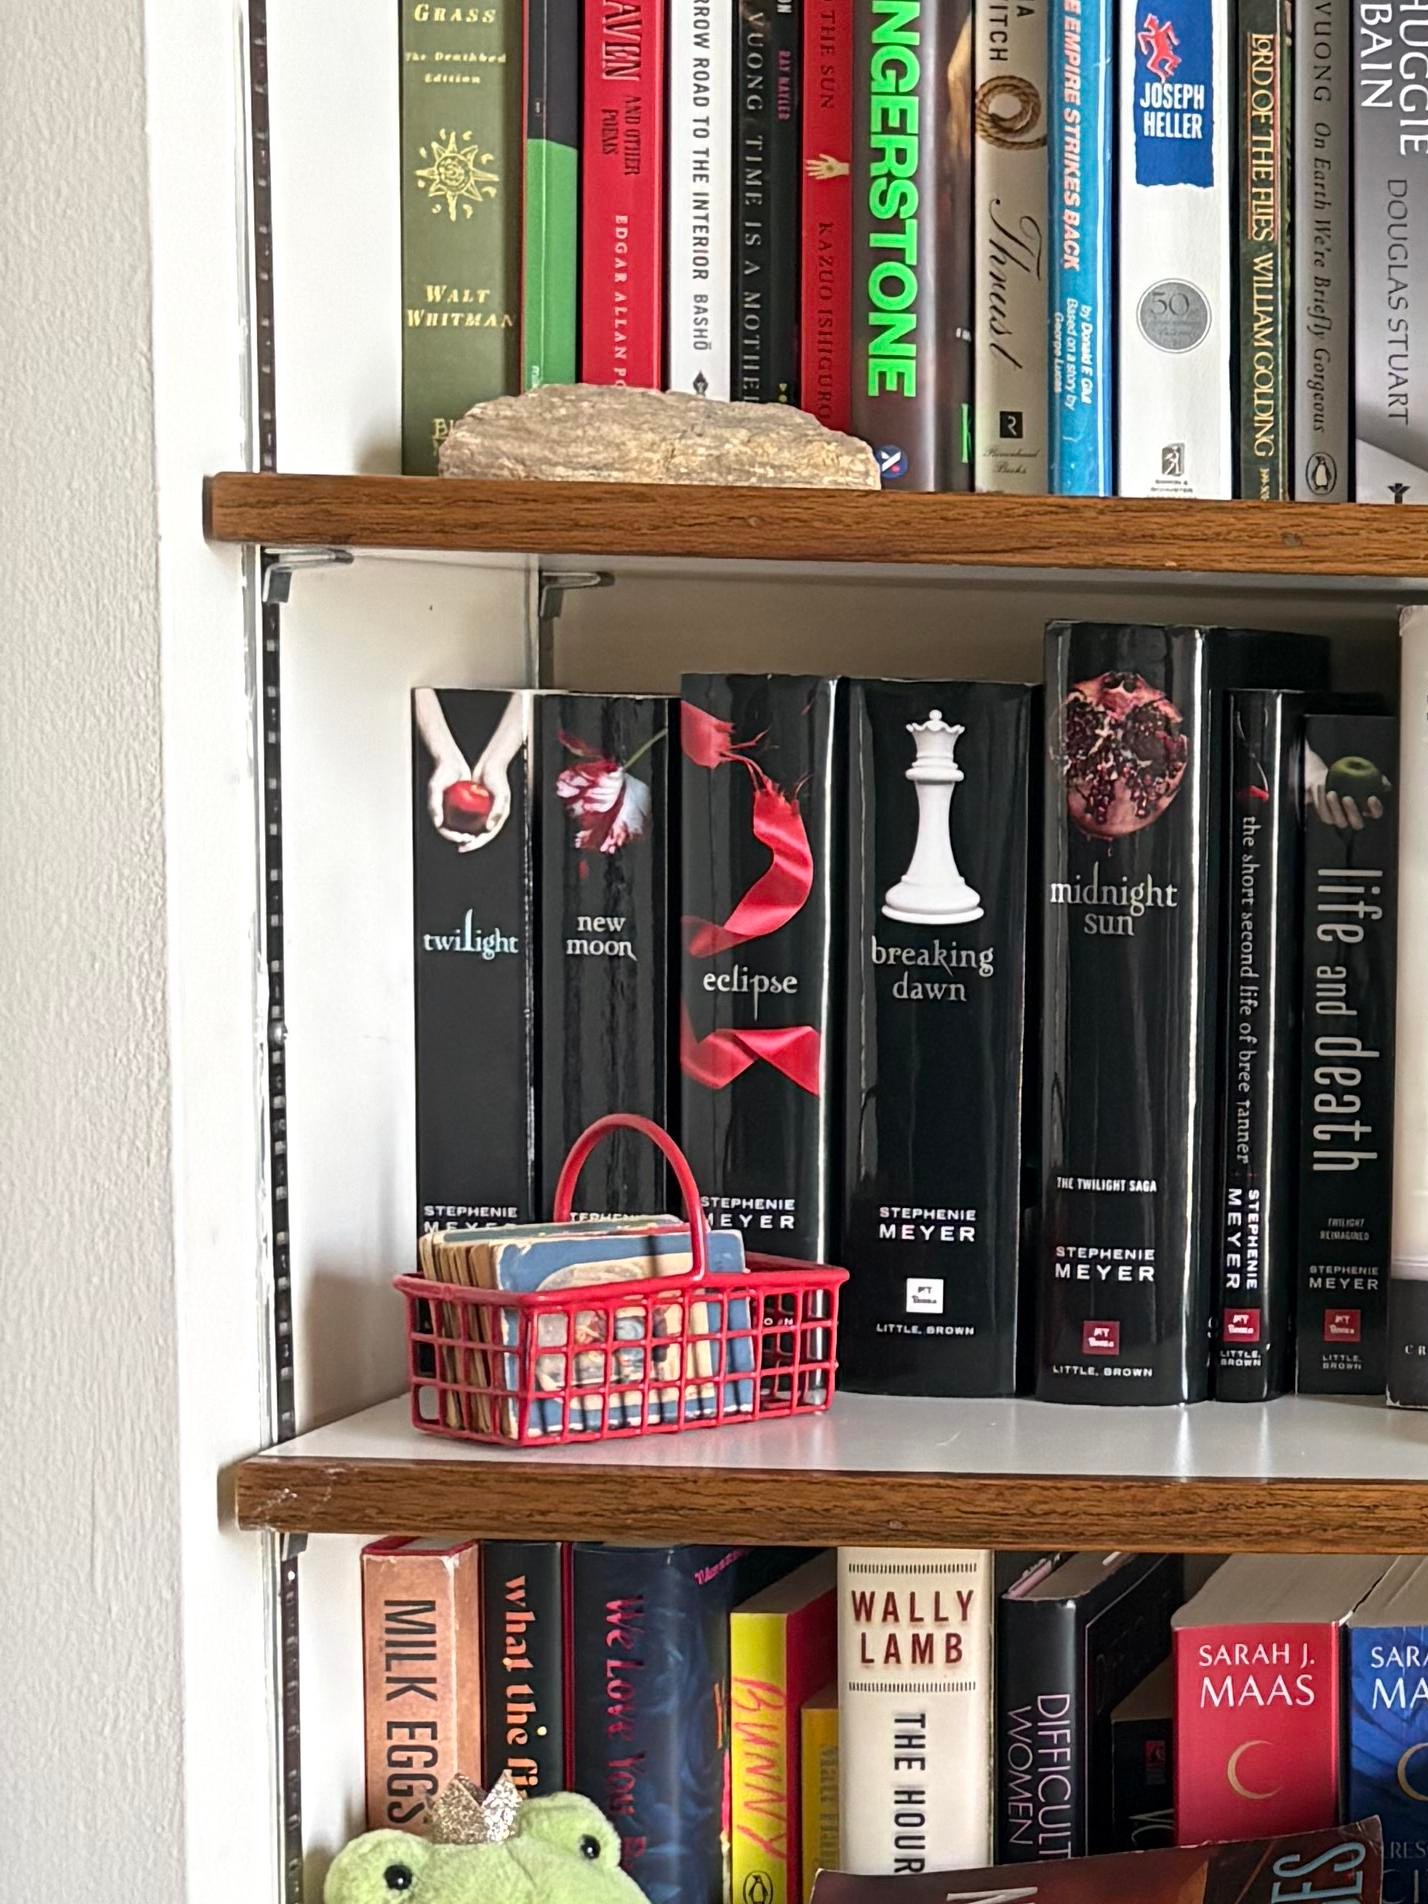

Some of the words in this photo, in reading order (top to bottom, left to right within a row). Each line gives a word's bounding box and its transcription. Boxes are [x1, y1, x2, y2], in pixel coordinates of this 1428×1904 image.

[1359, 3, 1393, 110] BAIN
[1140, 82, 1205, 115] JOSEPH
[1143, 111, 1203, 140] HELLER
[423, 908, 519, 961] twilight
[576, 912, 626, 934] new
[566, 934, 637, 961] moon
[871, 936, 995, 978] breaking
[702, 967, 798, 1017] eclipse
[892, 972, 967, 1002] dawn
[1057, 1177, 1075, 1191] THE
[1078, 1178, 1123, 1192] TWILIGHT
[1126, 1179, 1157, 1193] SAGA
[879, 1208, 976, 1222] STEPHENIE
[878, 1223, 976, 1242] MEYER
[876, 1323, 921, 1336] LITTLE,
[926, 1325, 974, 1337] BROWN
[850, 1589, 975, 1624] WALLY
[859, 1631, 965, 1665] LAMB
[1198, 1645, 1293, 1667] SARAH
[1299, 1644, 1316, 1668] J.
[1199, 1675, 1317, 1707] MAAS
